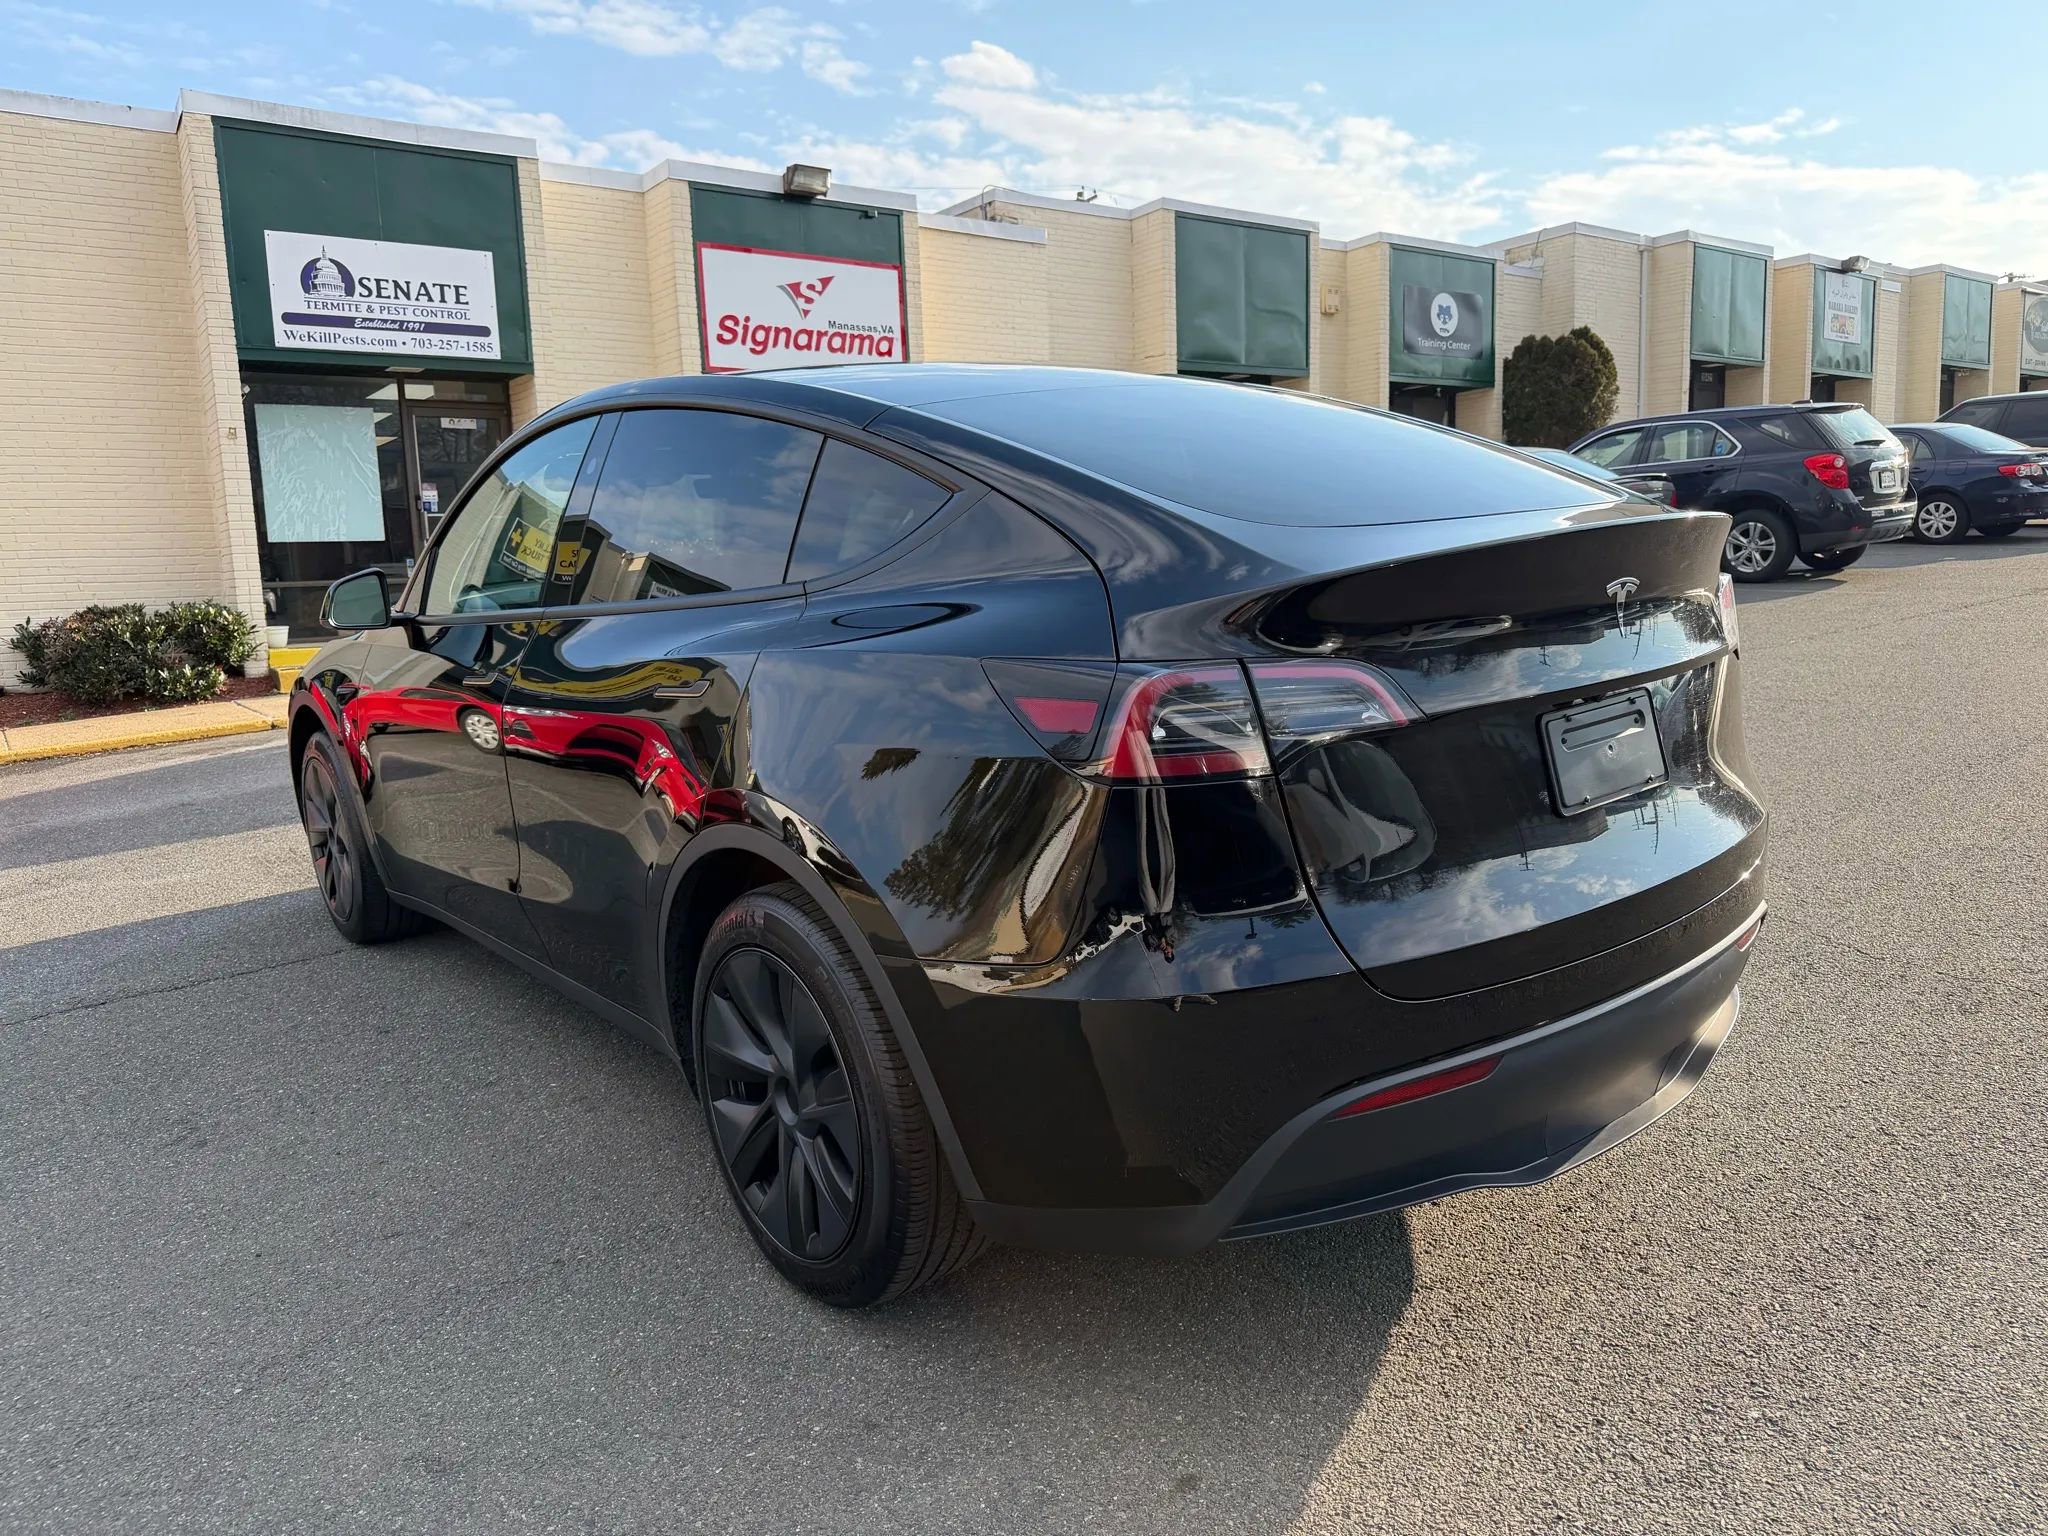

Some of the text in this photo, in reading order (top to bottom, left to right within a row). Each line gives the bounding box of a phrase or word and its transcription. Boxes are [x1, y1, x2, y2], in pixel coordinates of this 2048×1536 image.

[358, 276, 470, 306] SENATE
[304, 300, 470, 320] TERMITE & PEST CONTROL
[354, 318, 425, 331] Established 1991
[283, 330, 494, 353] WeKillPests.com 703-257-1585
[716, 314, 895, 358] Signarama
[1417, 337, 1471, 351] Training Center
